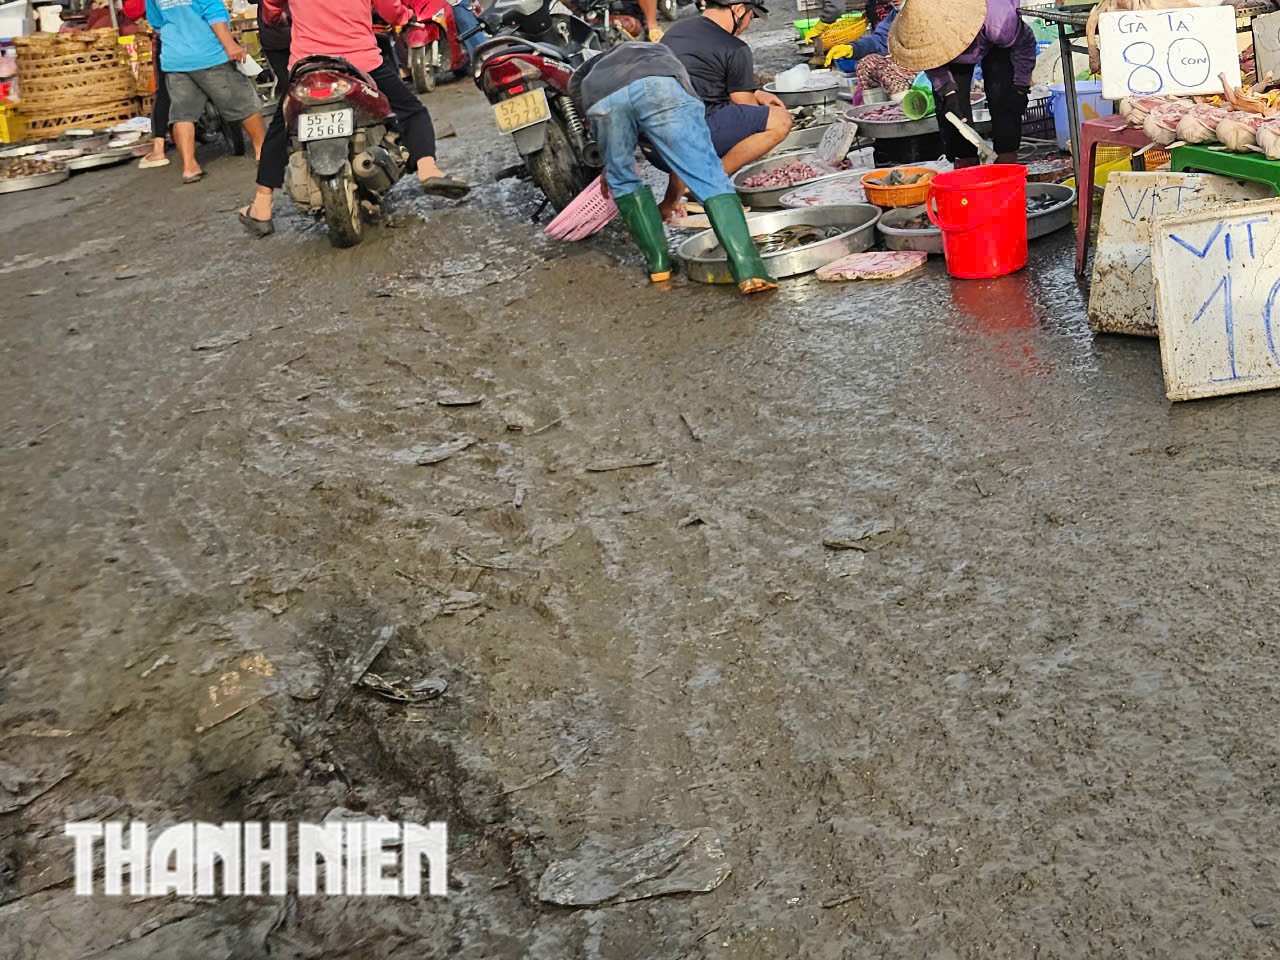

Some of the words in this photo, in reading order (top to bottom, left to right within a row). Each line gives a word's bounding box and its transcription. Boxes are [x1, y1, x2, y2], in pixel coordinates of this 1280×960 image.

[1157, 10, 1190, 32] TA
[1122, 37, 1211, 95] 80
[1181, 56, 1208, 65] CON
[307, 111, 344, 126] 55-Y2
[307, 123, 345, 139] 2566
